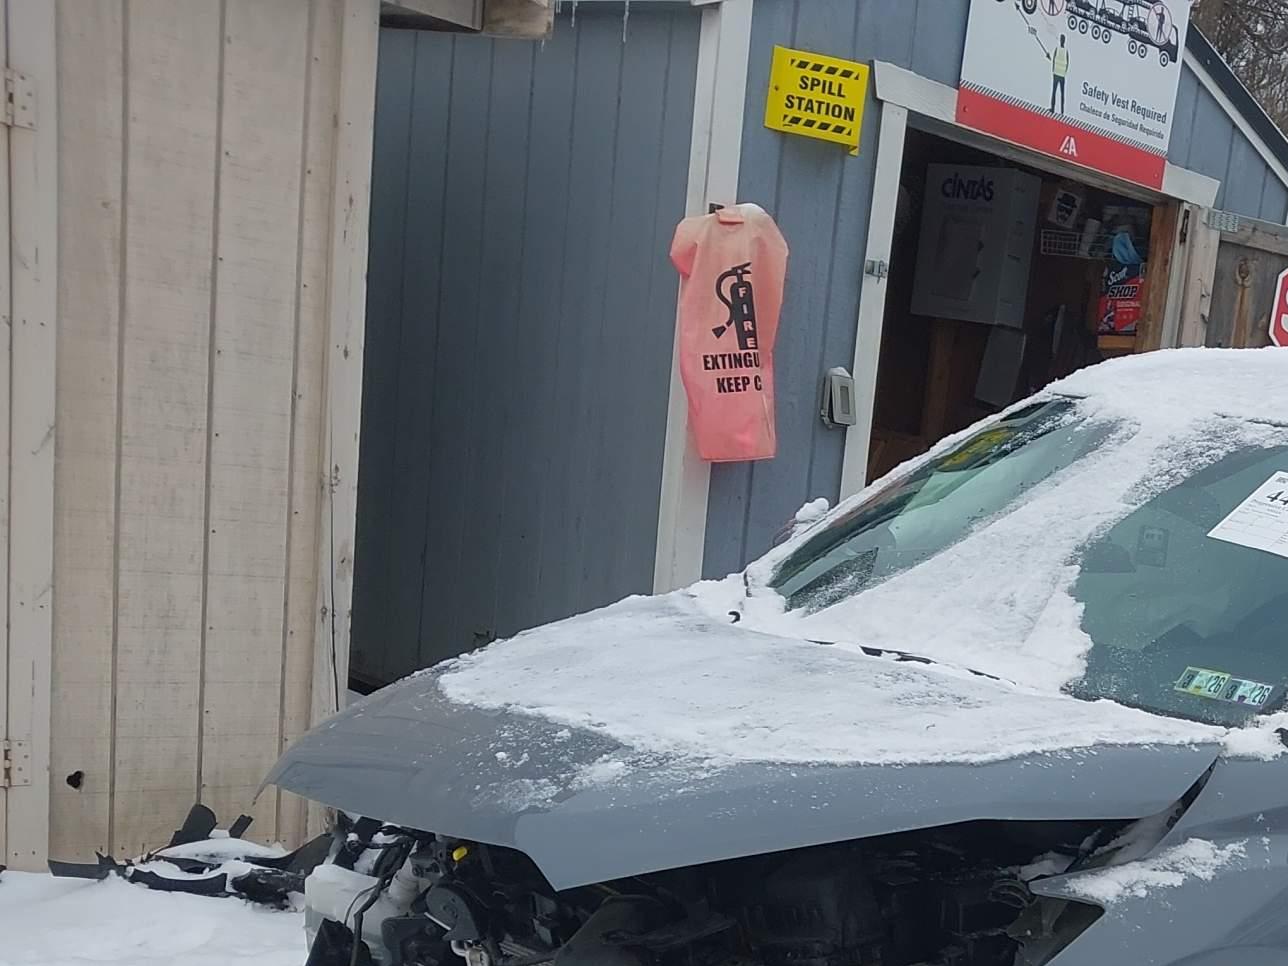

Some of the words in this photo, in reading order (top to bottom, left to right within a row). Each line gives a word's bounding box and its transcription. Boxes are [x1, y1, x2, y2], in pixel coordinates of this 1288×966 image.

[799, 75, 846, 98] SPILL
[785, 94, 855, 122] STATION
[1081, 82, 1109, 105] Safety
[1111, 92, 1130, 110] Vest
[1130, 100, 1167, 124] Required
[1103, 111, 1111, 120] de
[942, 172, 994, 202] CINTAS
[1109, 285, 1138, 298] SHOP
[738, 287, 757, 348] FIRE
[716, 376, 751, 394] KEEP
